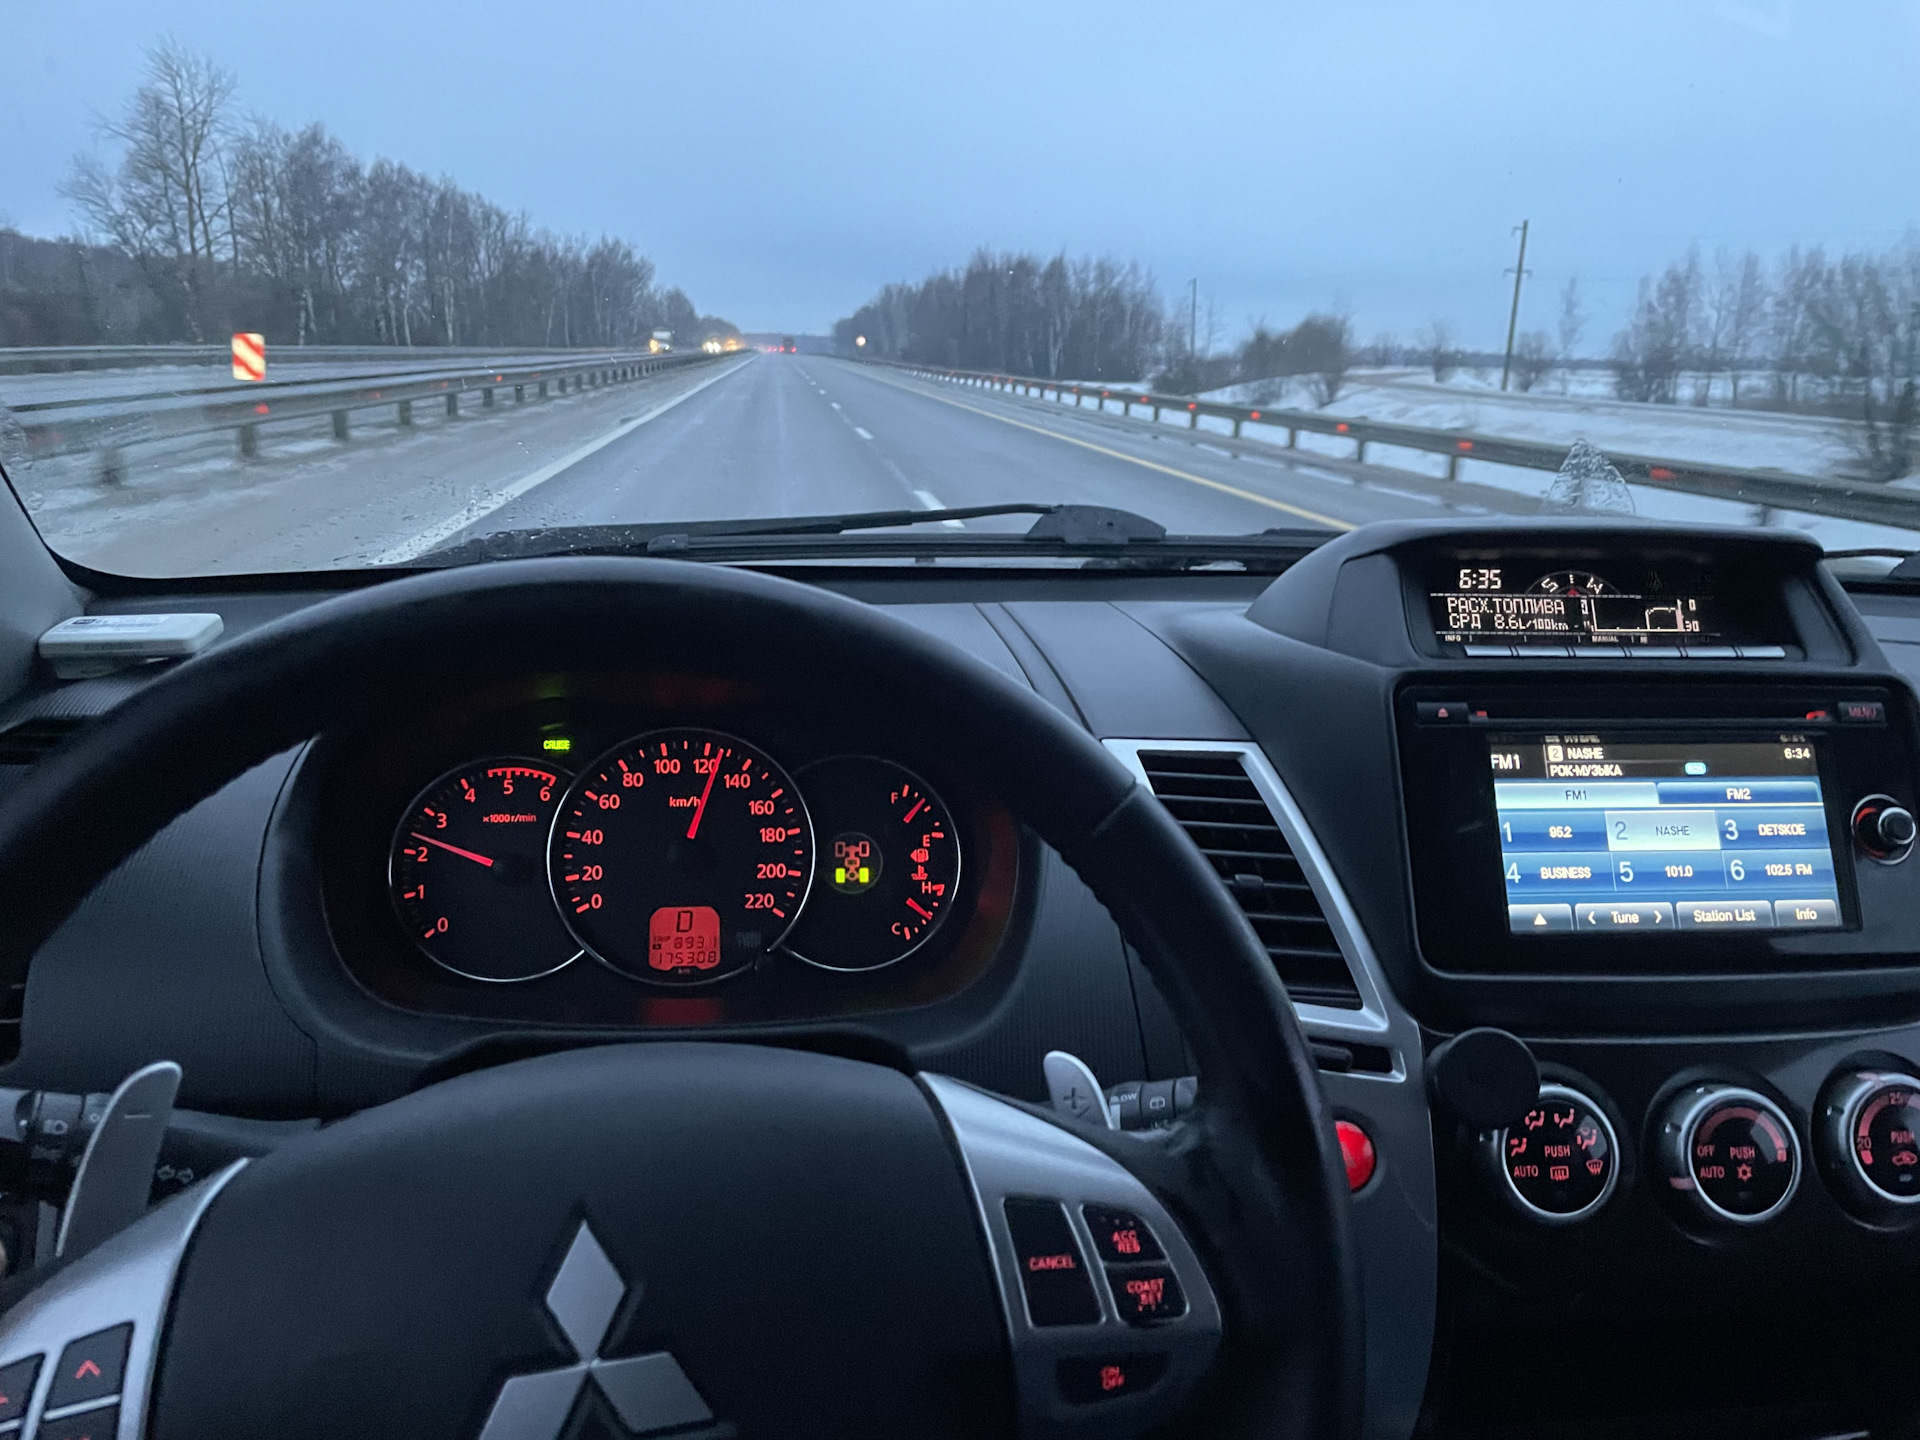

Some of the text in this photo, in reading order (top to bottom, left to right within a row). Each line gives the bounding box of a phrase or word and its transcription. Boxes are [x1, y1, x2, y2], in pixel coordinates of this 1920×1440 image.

[1459, 569, 1502, 589] 6:35
[1449, 614, 1481, 629] СРД
[1848, 707, 1876, 718] MENU
[543, 740, 570, 750] CRUISE
[1552, 748, 1604, 760] 2 NASHE
[1783, 747, 1810, 759] 6:34
[654, 759, 680, 774] 100
[693, 759, 717, 774] 120
[1490, 754, 1521, 770] FM1
[1550, 764, 1623, 777] РОК-МУЗЫКА
[622, 772, 644, 787] 80
[724, 774, 750, 788] 140
[503, 780, 513, 795] 5
[540, 786, 550, 802] 6
[1726, 788, 1752, 800] FM2
[464, 788, 476, 802] 4
[599, 794, 620, 809] 60
[669, 796, 700, 807] km/h
[891, 792, 898, 804] F
[1565, 790, 1588, 800] FM1
[749, 800, 774, 815] 160
[436, 813, 447, 828] 3
[510, 813, 536, 822] r/min
[759, 827, 786, 843] 180
[1503, 821, 1513, 843] 1
[1615, 821, 1628, 840] 2
[1655, 826, 1690, 836] NASHE
[1724, 819, 1739, 841] 3
[1758, 823, 1806, 836] DETSKOE
[581, 829, 603, 845] 40
[923, 834, 930, 847] E
[417, 846, 428, 862] 2
[582, 865, 603, 881] 20
[756, 864, 786, 879] 200
[1506, 862, 1521, 884] 4
[1540, 867, 1592, 879] BUSINESS
[1619, 861, 1634, 882] 5
[1665, 864, 1693, 878] 101.0
[1730, 859, 1745, 881] 6
[1765, 863, 1813, 876] 102.5 FM
[417, 885, 424, 899] 1
[922, 881, 931, 894] H
[591, 894, 602, 909] 0
[744, 894, 774, 909] 220
[1611, 911, 1639, 924] Tune
[1694, 909, 1756, 923] Station List
[1796, 908, 1817, 920] Info
[437, 917, 448, 932] 0
[891, 922, 900, 935] C
[659, 951, 717, 964] 175308
[1857, 1137, 1872, 1150] 20
[1890, 1130, 1915, 1143] PUSH
[1544, 1144, 1570, 1158] PUSH
[1697, 1145, 1716, 1158] OFF
[1729, 1146, 1755, 1160] PUSH
[1514, 1165, 1539, 1178] AUTO
[1700, 1166, 1725, 1179] AUTO
[1112, 1230, 1137, 1242] ACC
[1029, 1255, 1076, 1271] CANCEL
[1126, 1278, 1165, 1293] COAST
[1139, 1292, 1162, 1306] SET
